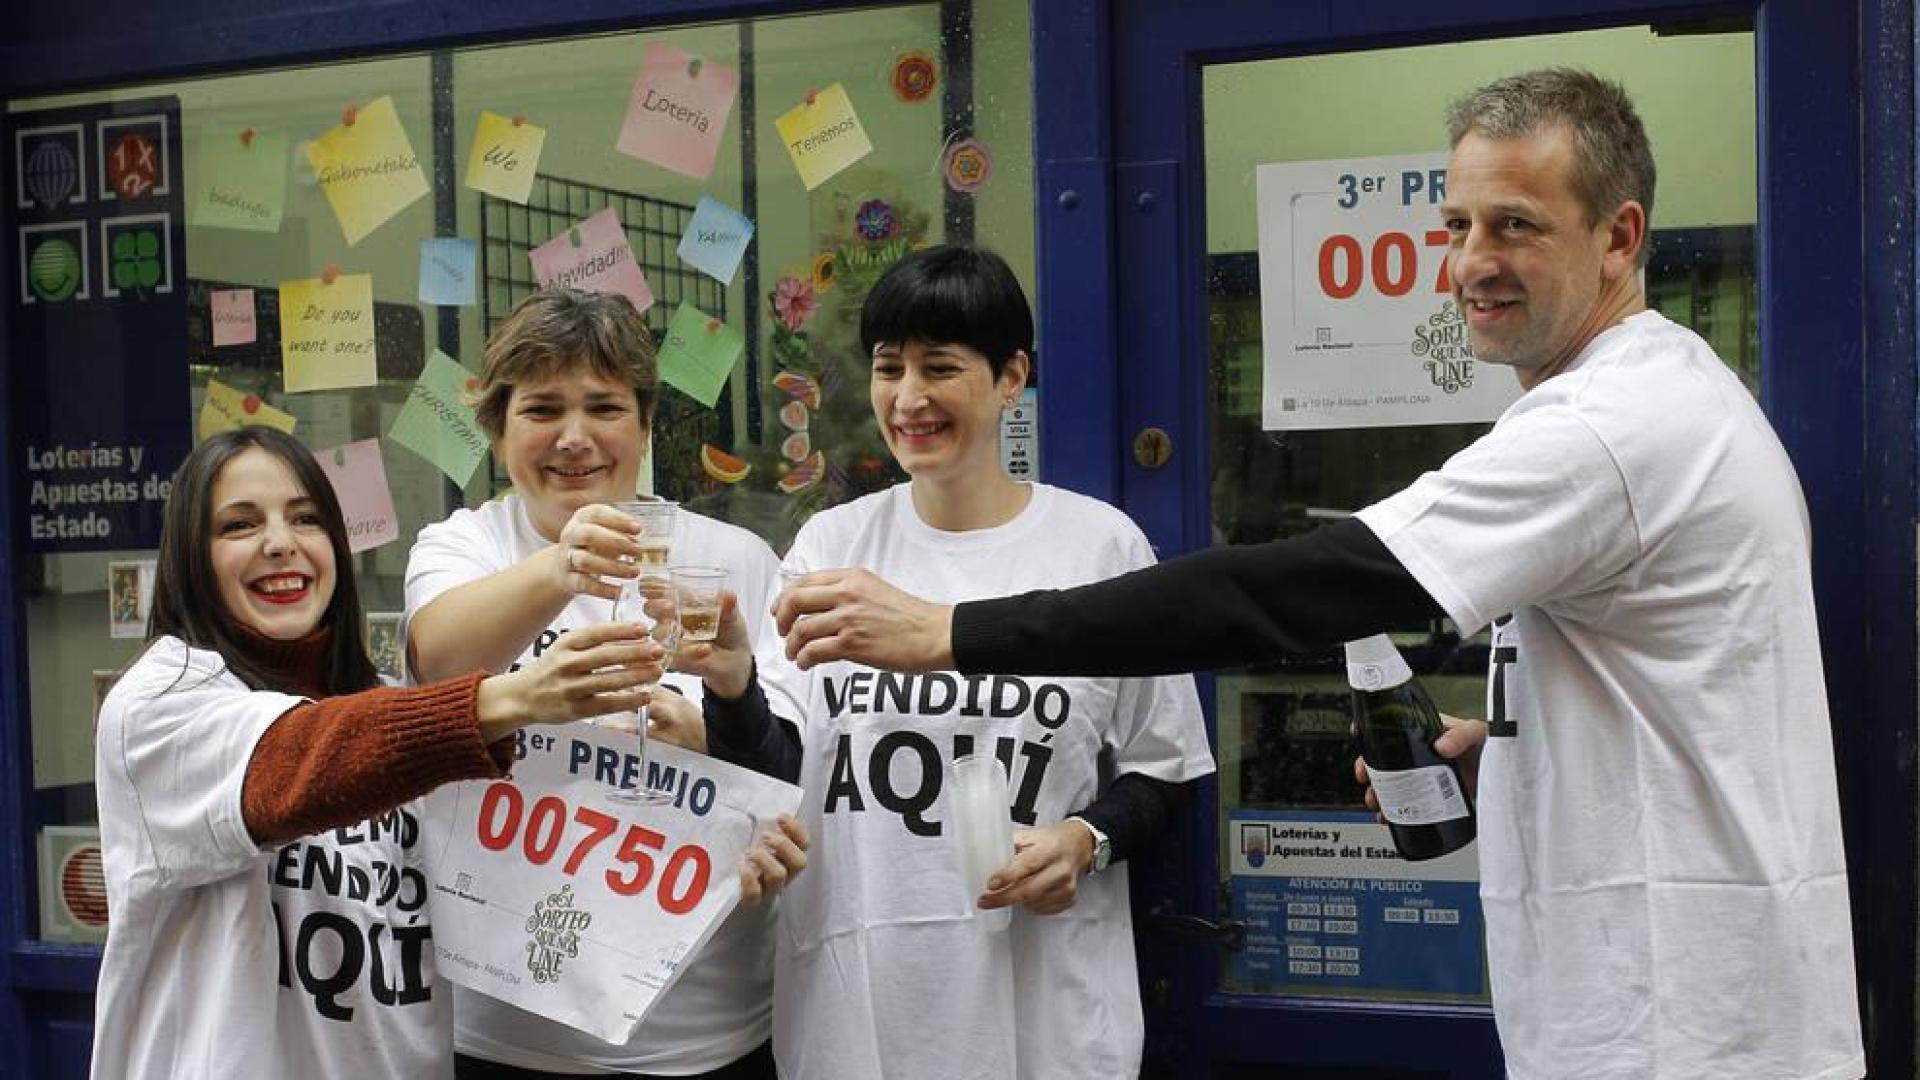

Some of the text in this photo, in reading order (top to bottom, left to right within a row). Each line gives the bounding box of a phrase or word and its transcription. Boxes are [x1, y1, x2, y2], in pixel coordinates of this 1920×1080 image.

[791, 116, 856, 156] Tenemos
[482, 145, 518, 172] We
[1317, 230, 1451, 299] 007
[330, 309, 360, 327] you
[288, 338, 376, 355] want one?
[128, 444, 144, 472] y
[30, 475, 138, 505] Apuestas
[30, 511, 112, 540] Estado
[823, 671, 1072, 730] VENDIDO
[568, 737, 718, 818] PREMIO
[477, 781, 712, 917] 00750
[1333, 829, 1342, 843] y
[1271, 845, 1401, 860] Apuestas del Esta
